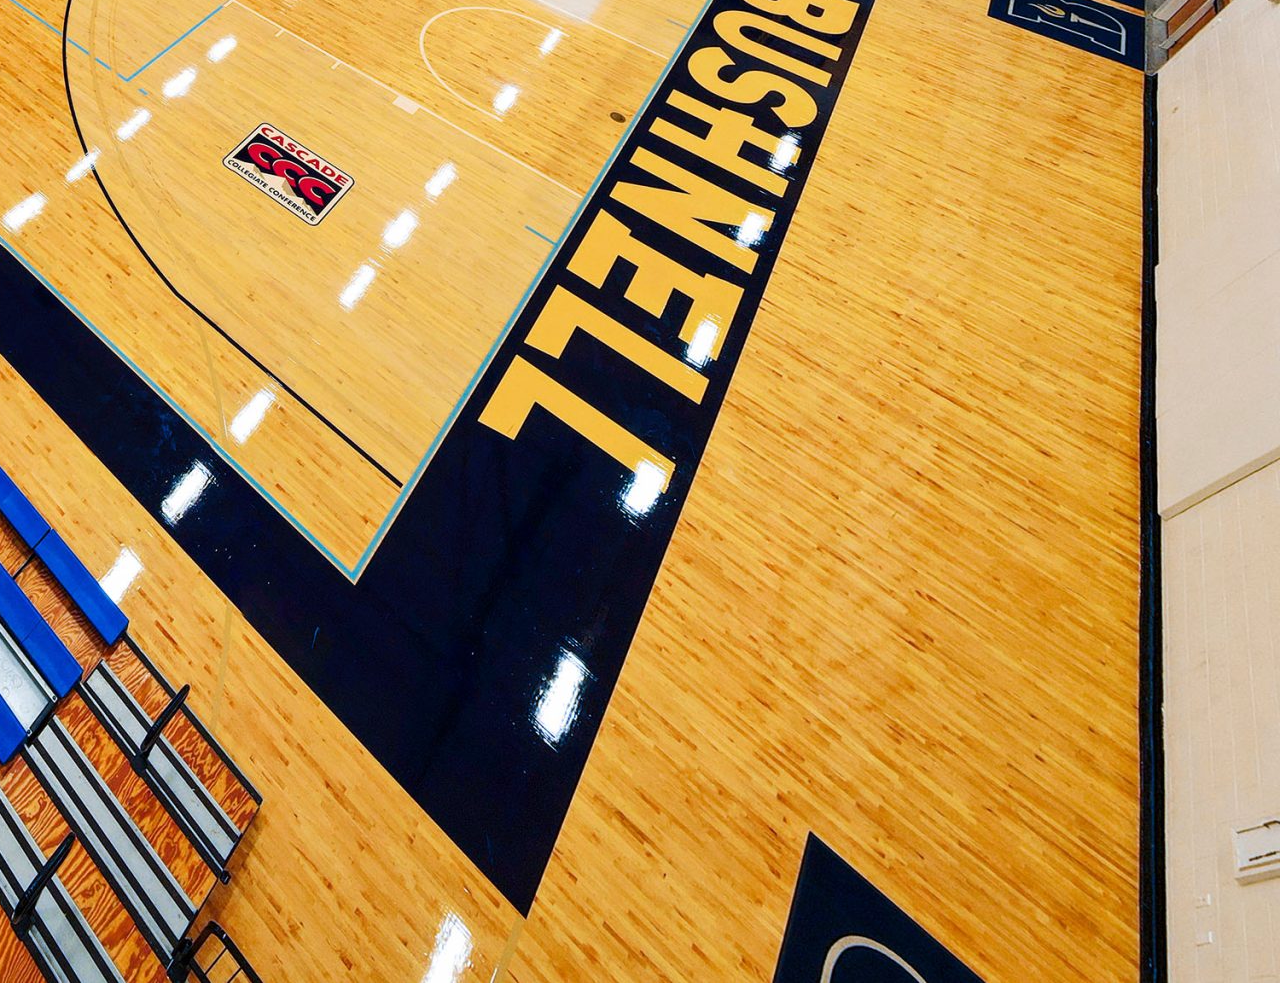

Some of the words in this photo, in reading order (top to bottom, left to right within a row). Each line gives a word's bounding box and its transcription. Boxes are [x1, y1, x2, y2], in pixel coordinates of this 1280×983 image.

[247, 142, 337, 206] CCC
[261, 127, 349, 187] CASCADE
[227, 159, 269, 188] COLLEGIATE
[268, 187, 317, 222] CONFERENCE
